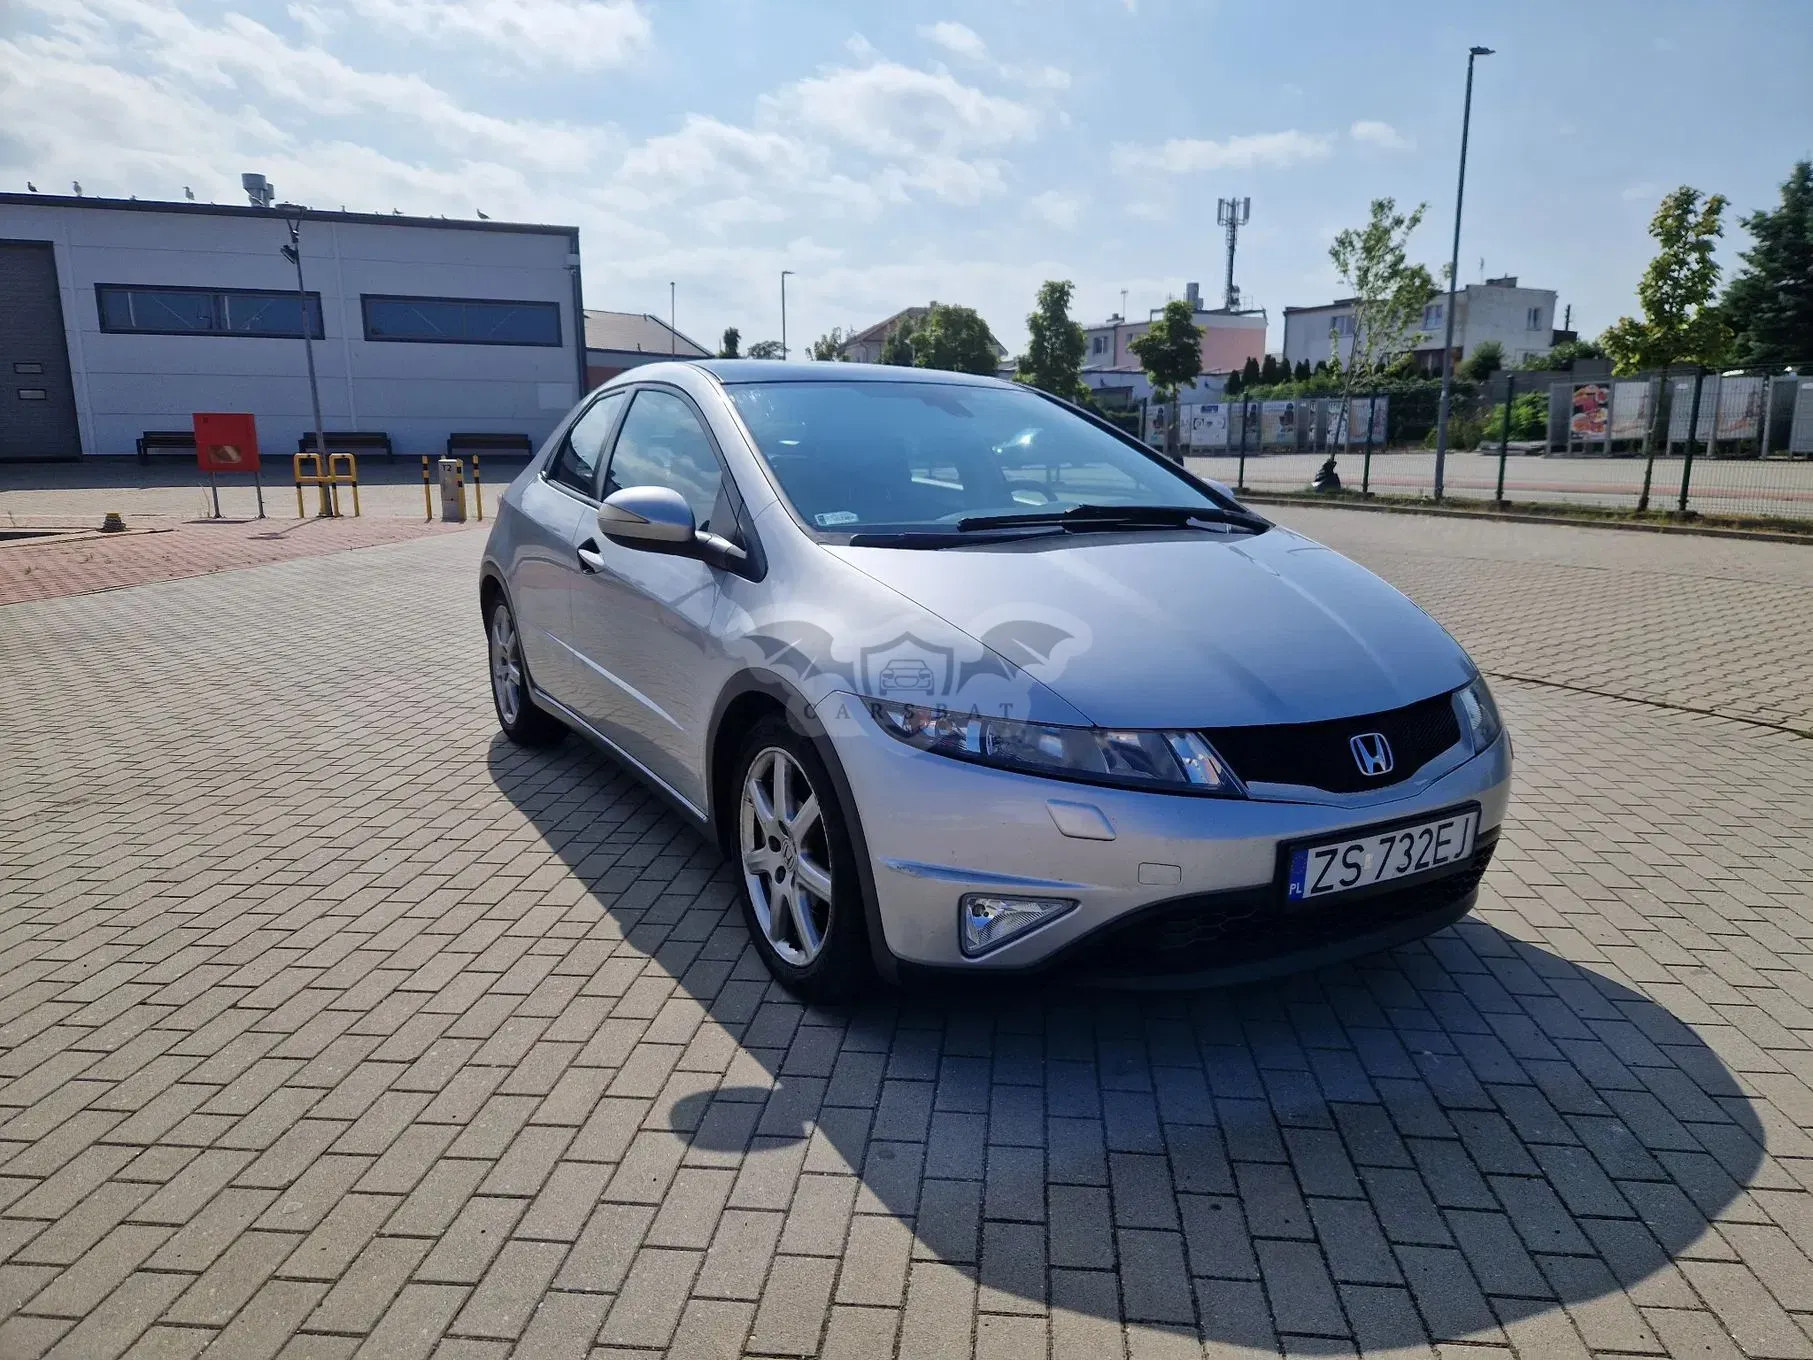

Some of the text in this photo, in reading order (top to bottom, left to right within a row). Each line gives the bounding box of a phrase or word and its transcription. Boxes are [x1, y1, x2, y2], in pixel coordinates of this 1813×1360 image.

[442, 464, 452, 472] T2
[1310, 817, 1470, 894] ZS 732EJ
[1289, 882, 1302, 896] PL
